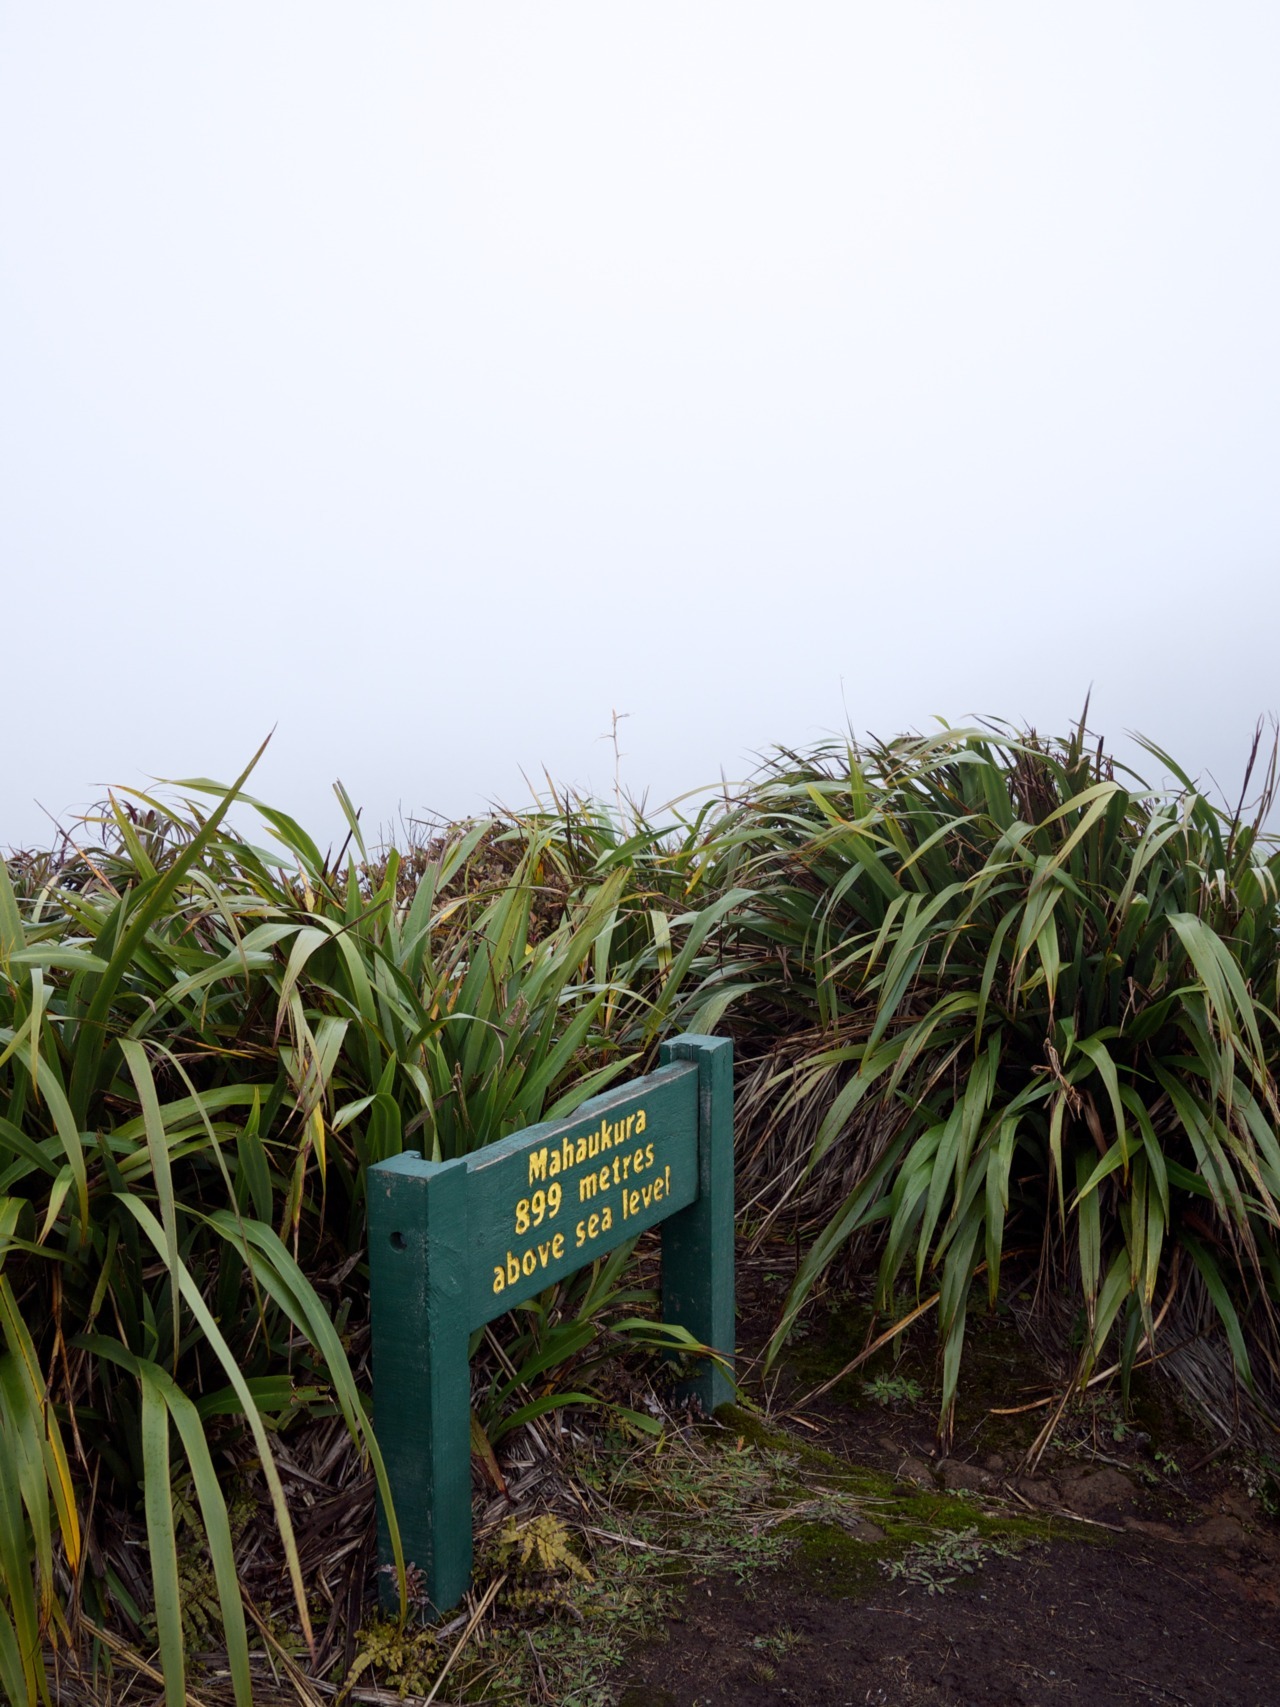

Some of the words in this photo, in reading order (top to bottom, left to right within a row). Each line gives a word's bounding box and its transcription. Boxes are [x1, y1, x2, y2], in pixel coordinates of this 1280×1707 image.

[515, 1181, 563, 1235] 899
[579, 1143, 655, 1202] metres
[528, 1109, 647, 1185] Mahaukura
[492, 1232, 565, 1294] above
[575, 1206, 613, 1247] sea
[622, 1165, 671, 1220] level
